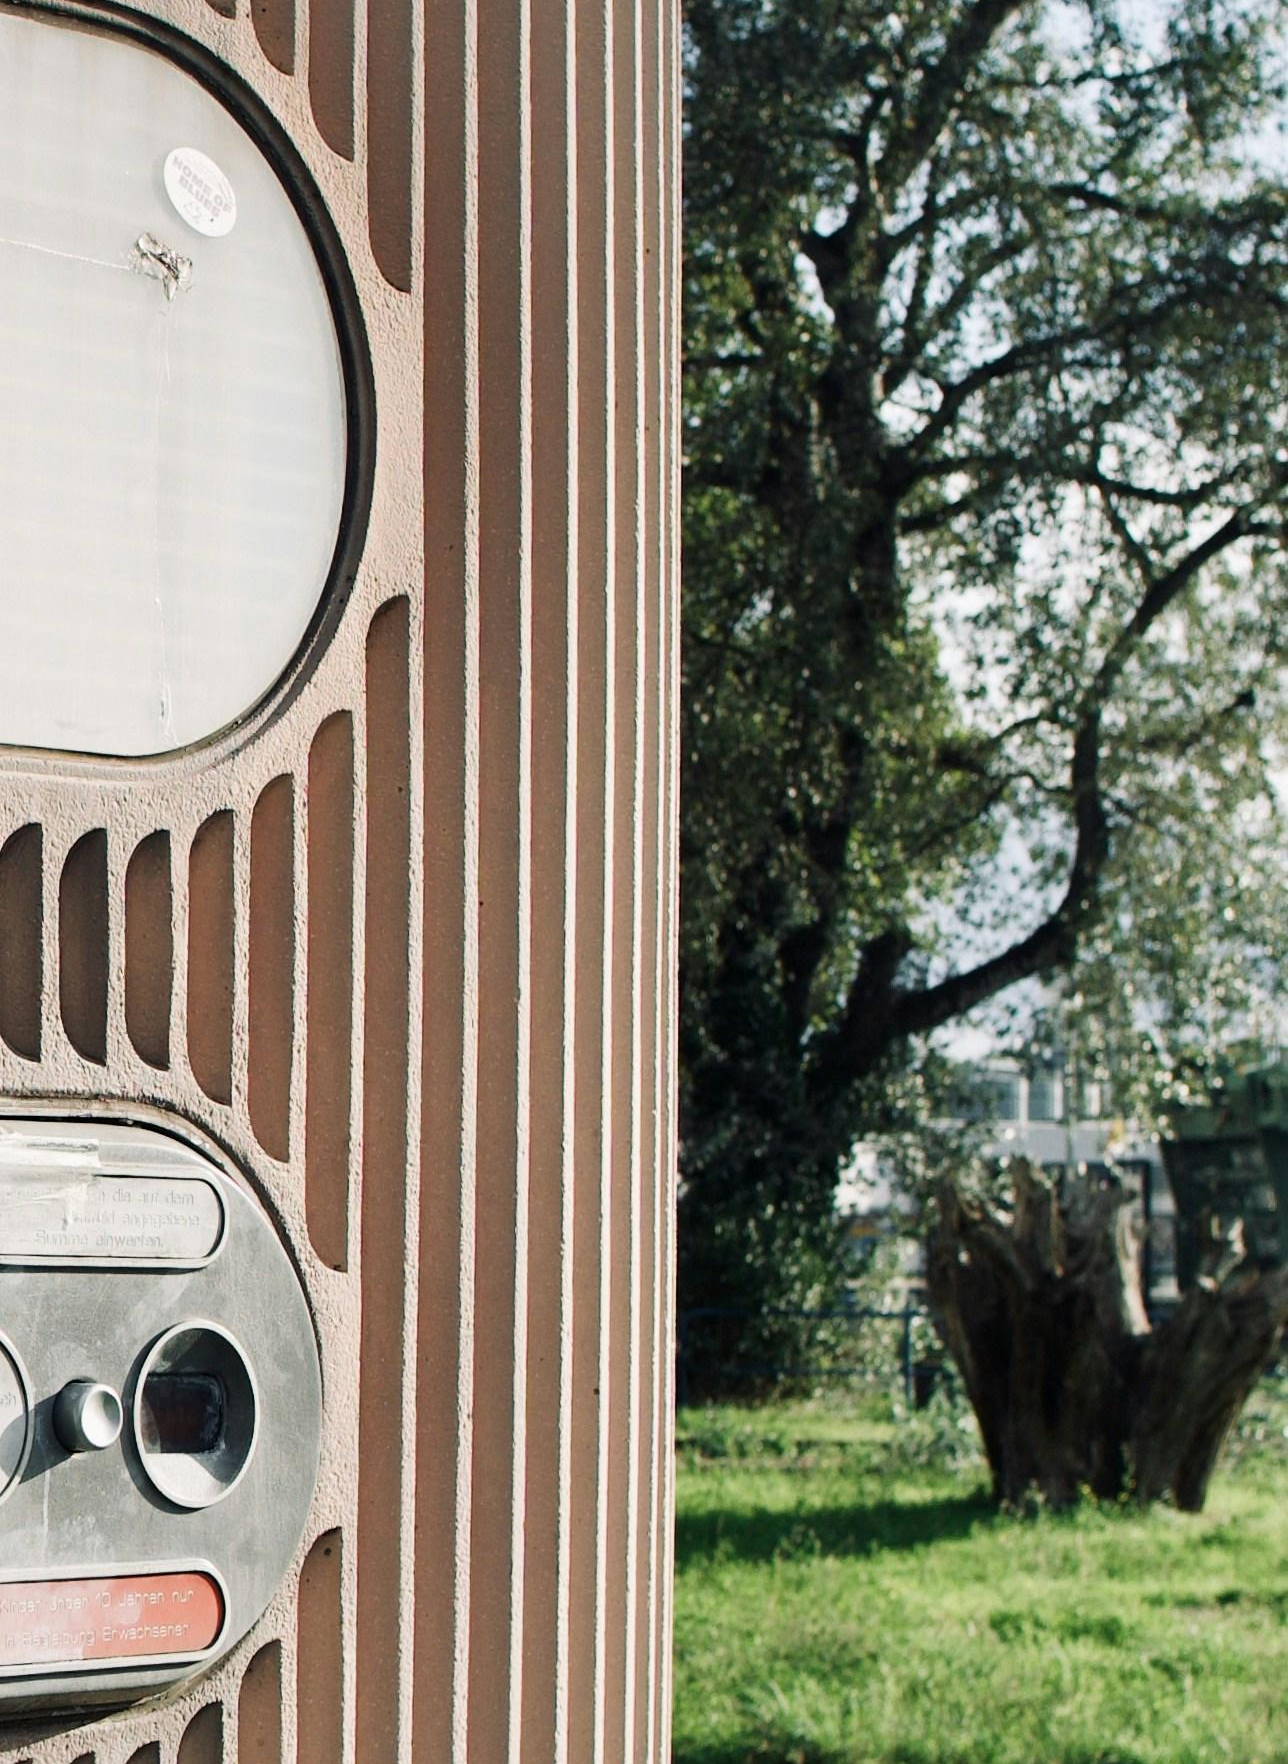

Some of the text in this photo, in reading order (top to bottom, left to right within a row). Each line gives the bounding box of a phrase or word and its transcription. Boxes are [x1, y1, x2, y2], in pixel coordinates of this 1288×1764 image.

[172, 155, 212, 197] HOME
[213, 194, 232, 214] OF
[179, 175, 221, 218] BLUES
[95, 1591, 111, 1608] 10
[117, 1589, 166, 1607] Jahren
[171, 1588, 195, 1604] nur
[101, 1624, 190, 1643] Erwachsener
